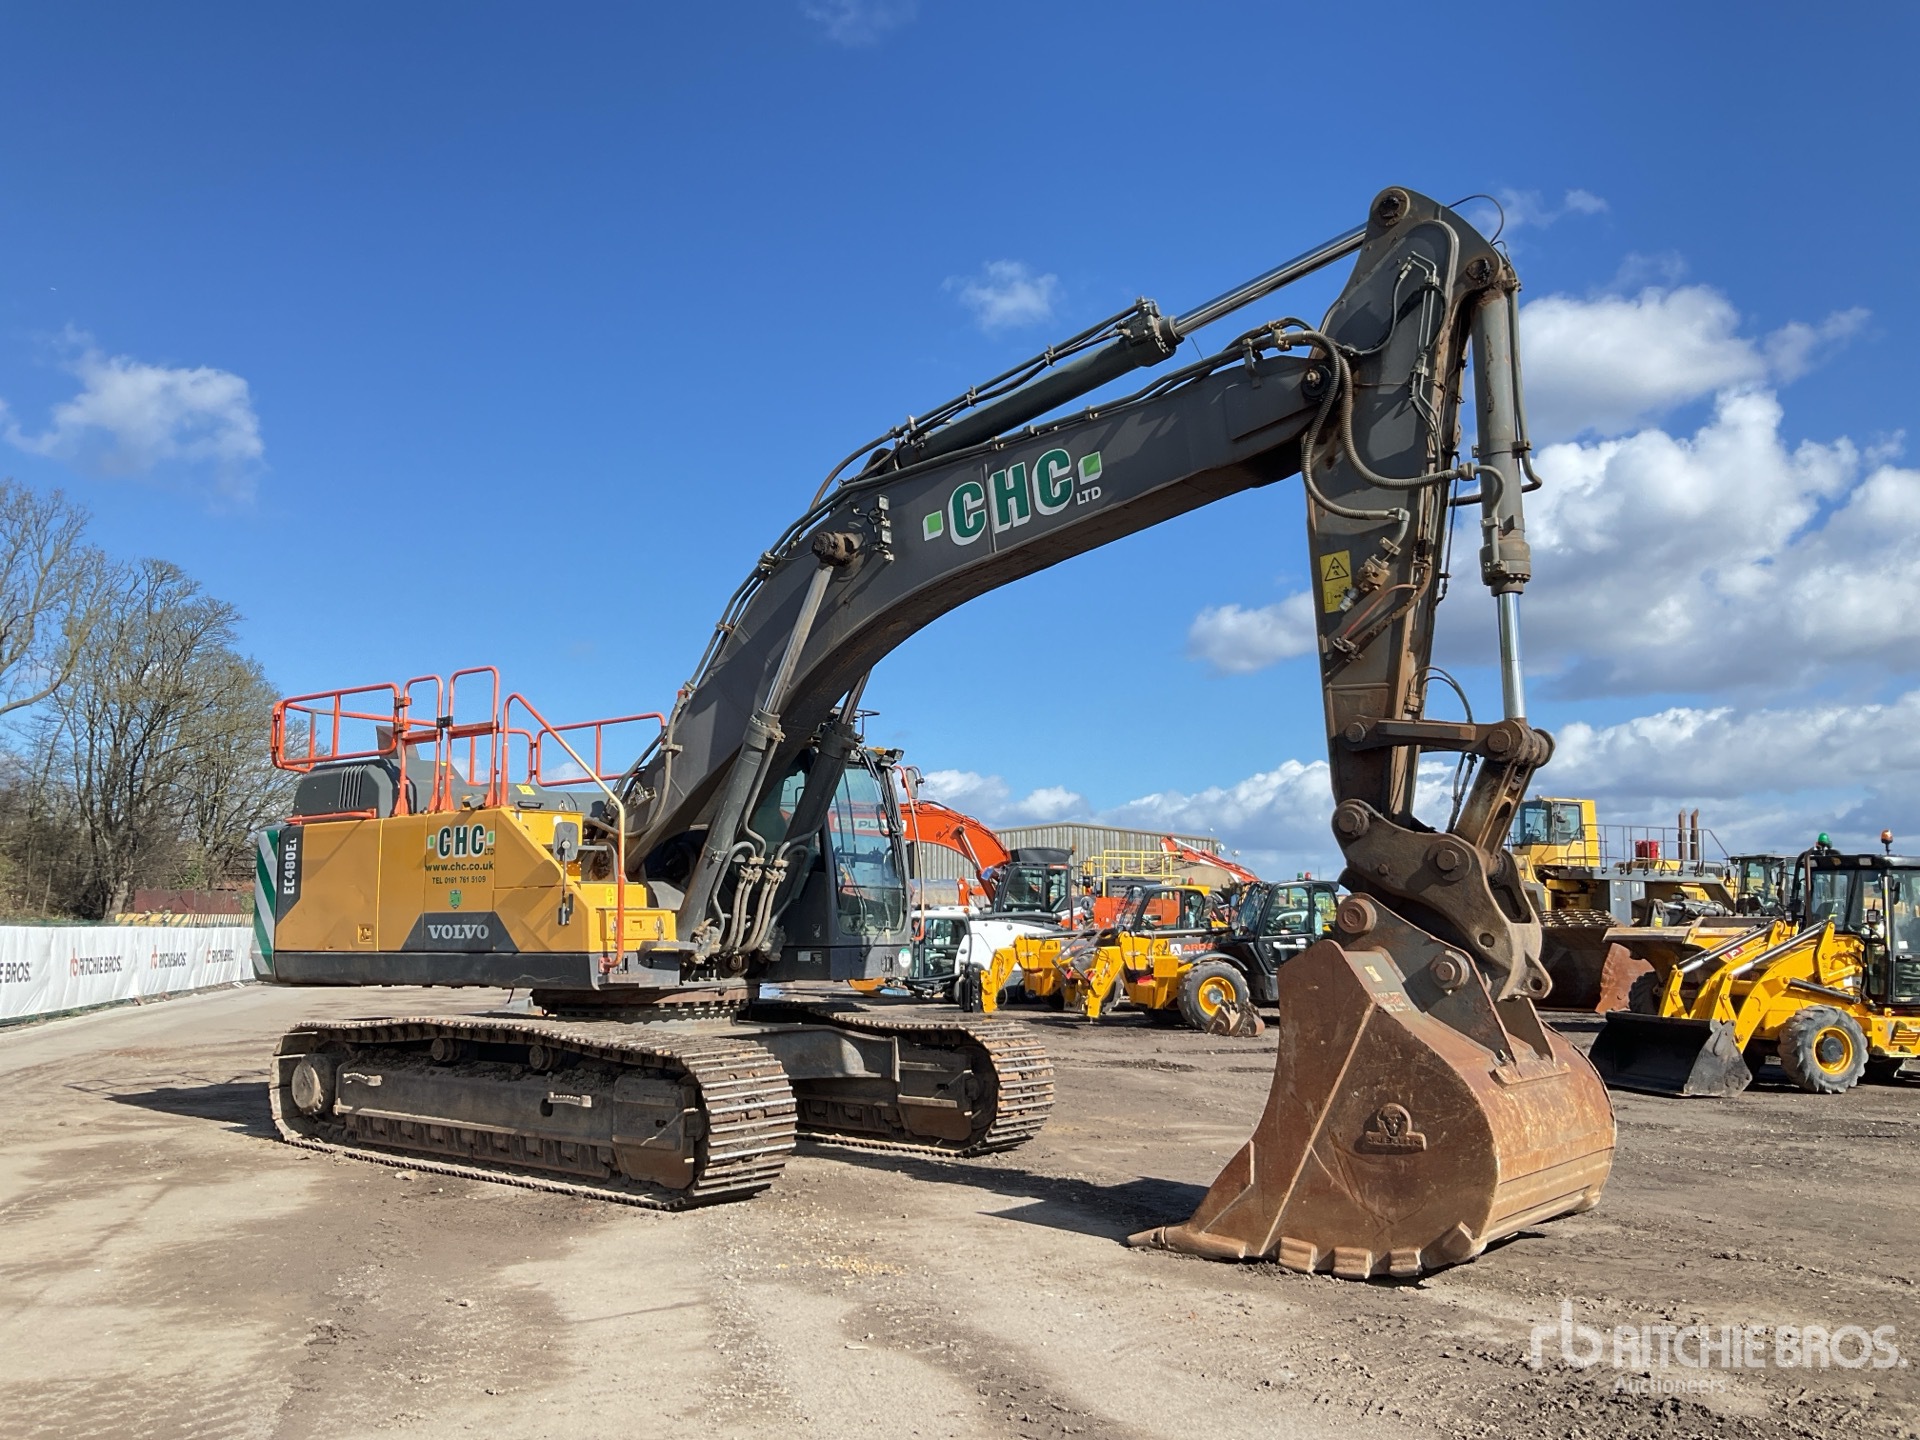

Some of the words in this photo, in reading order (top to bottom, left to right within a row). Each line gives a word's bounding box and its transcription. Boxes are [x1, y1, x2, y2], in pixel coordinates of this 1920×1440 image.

[948, 449, 1073, 545] CHC
[1077, 486, 1102, 505] LTD
[437, 823, 485, 859] CHC
[284, 838, 297, 895] EC480EL
[425, 861, 494, 871] www.chc.co.uk
[432, 877, 442, 885] TEL
[427, 924, 490, 940] VOLVO
